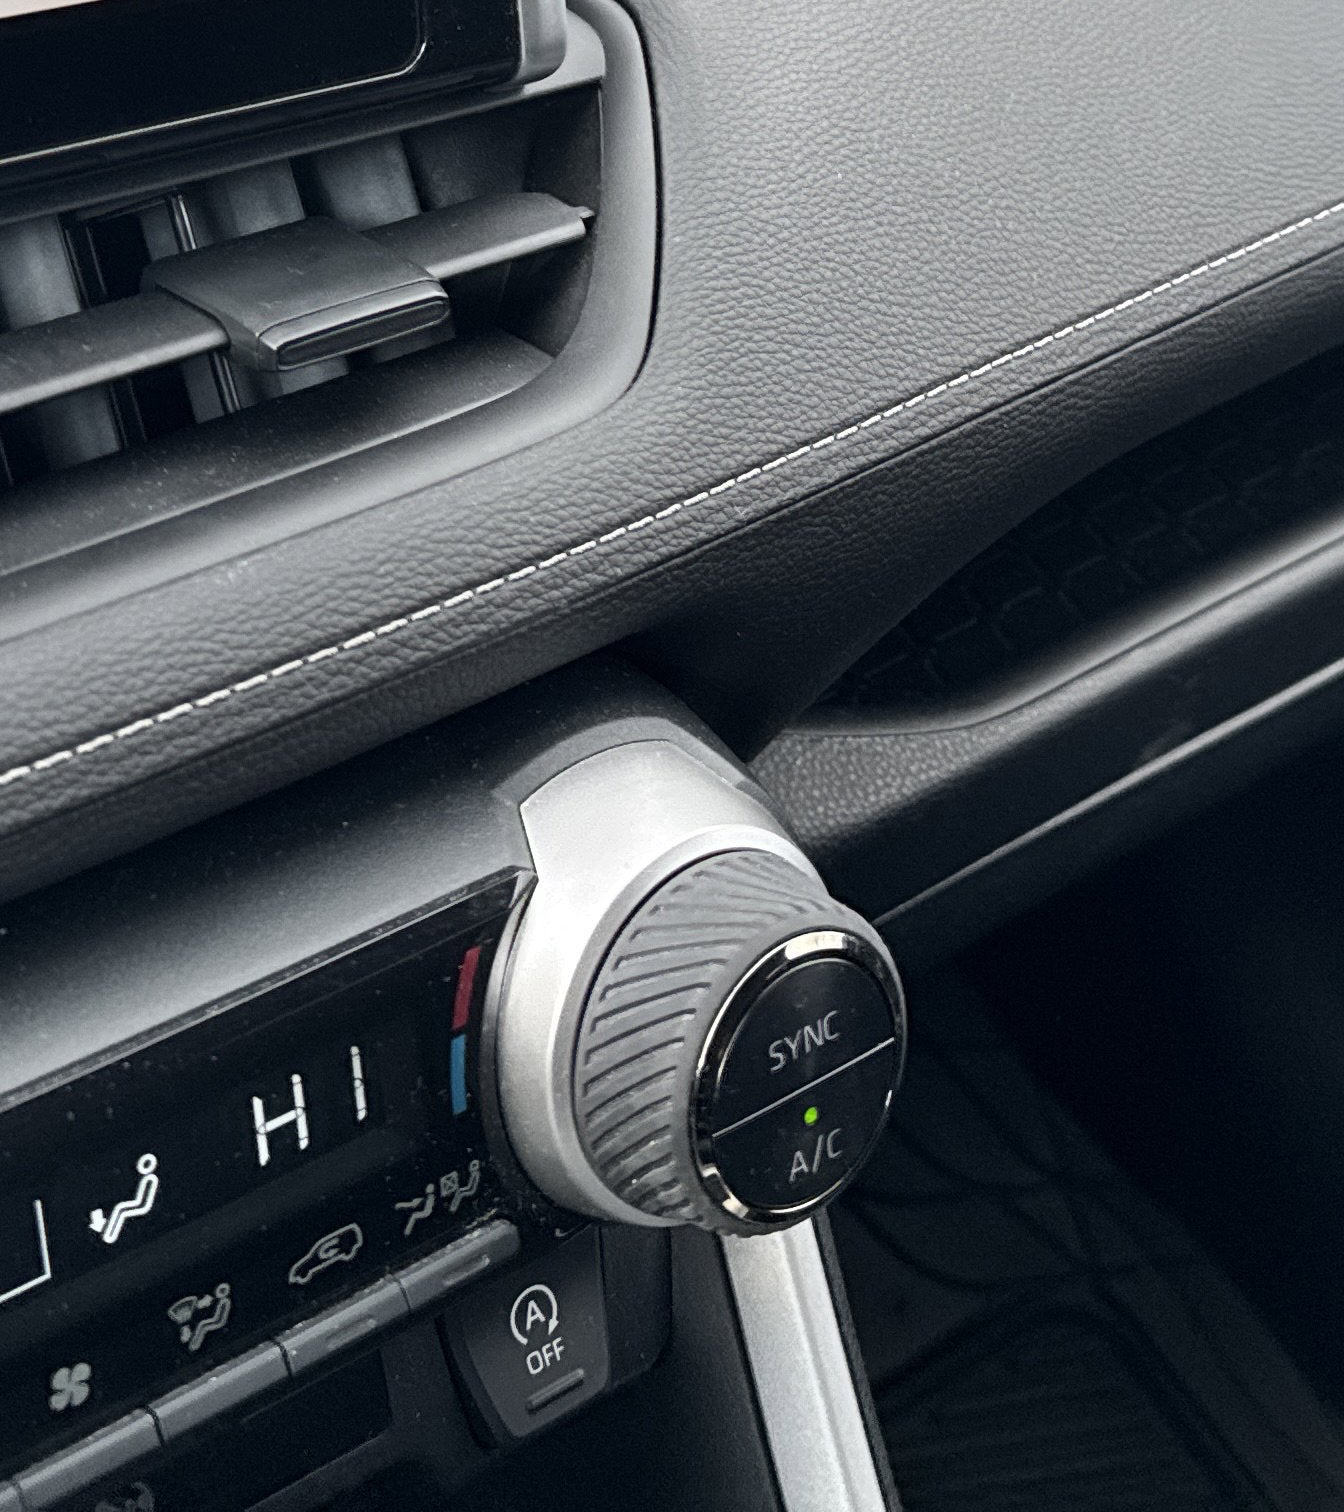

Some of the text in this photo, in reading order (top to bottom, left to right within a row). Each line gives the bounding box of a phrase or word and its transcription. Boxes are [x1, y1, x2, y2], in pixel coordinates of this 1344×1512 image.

[768, 1009, 841, 1073] SYNC
[251, 1045, 368, 1167] HI
[787, 1127, 844, 1184] A/C
[526, 1299, 546, 1331] A
[525, 1336, 565, 1375] OFF
